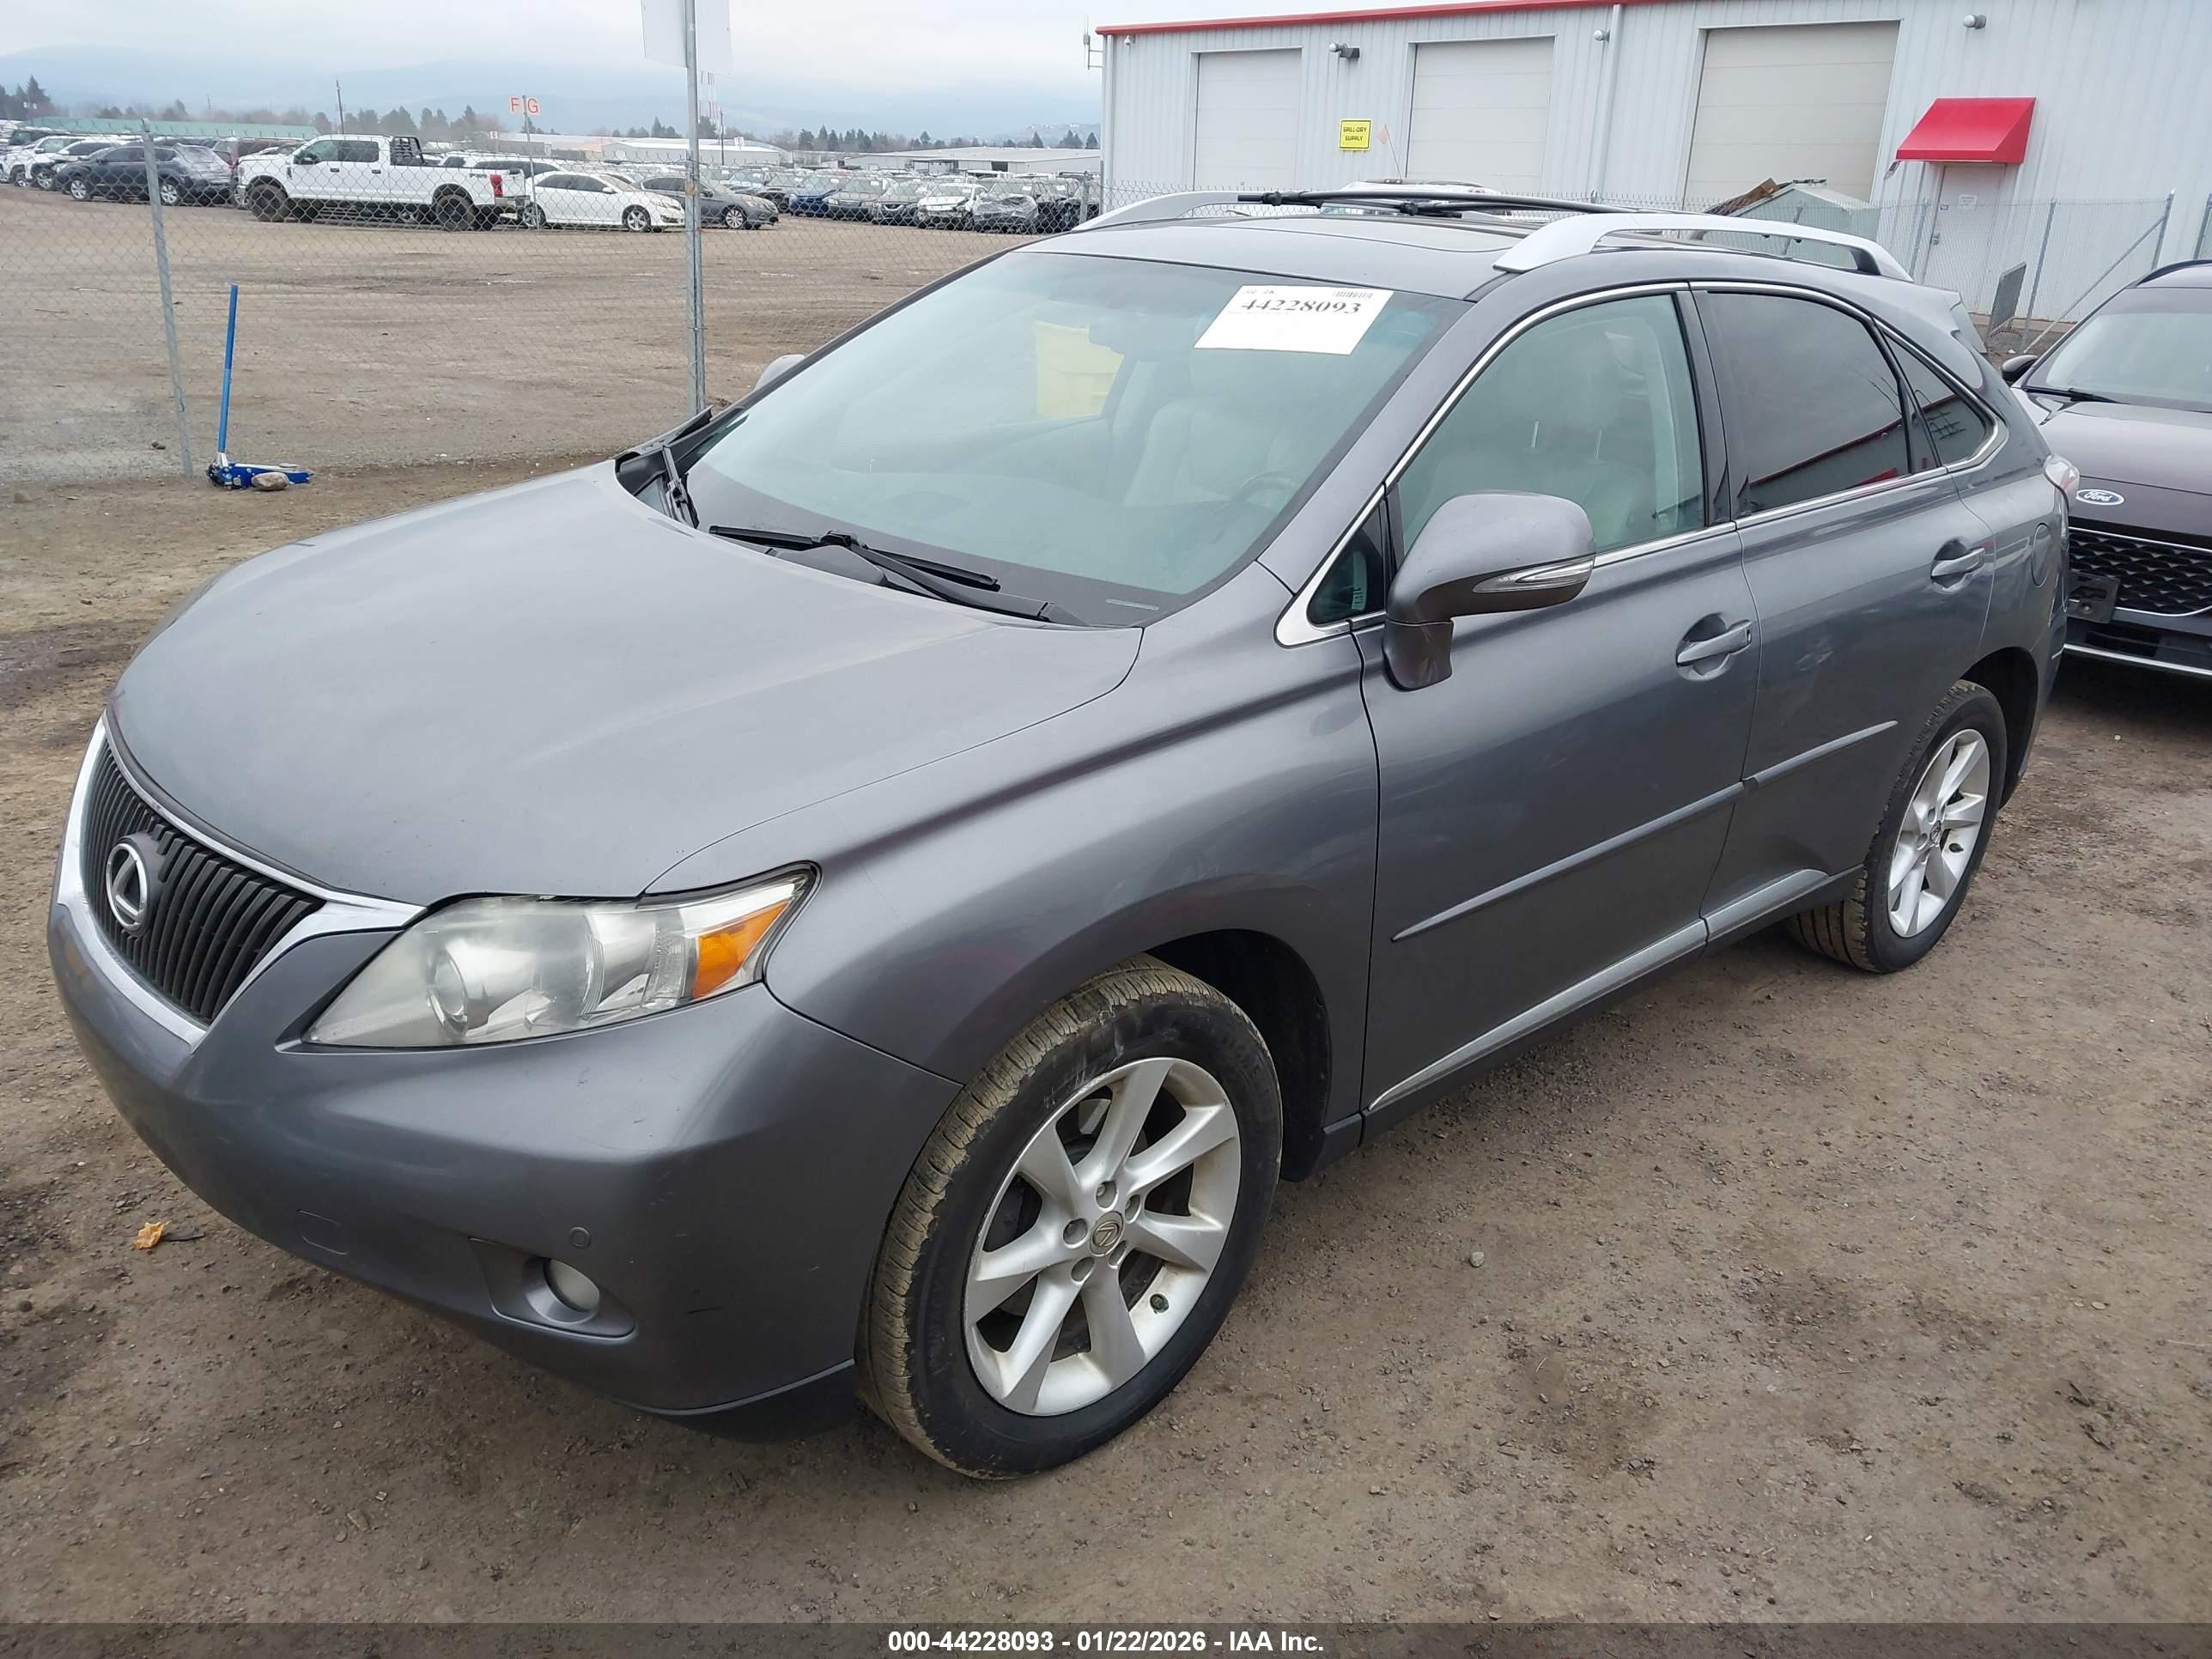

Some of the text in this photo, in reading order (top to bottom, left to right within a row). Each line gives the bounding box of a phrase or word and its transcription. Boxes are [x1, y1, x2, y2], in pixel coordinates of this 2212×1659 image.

[510, 97, 539, 113] F G
[1241, 299, 1361, 313] 44228093
